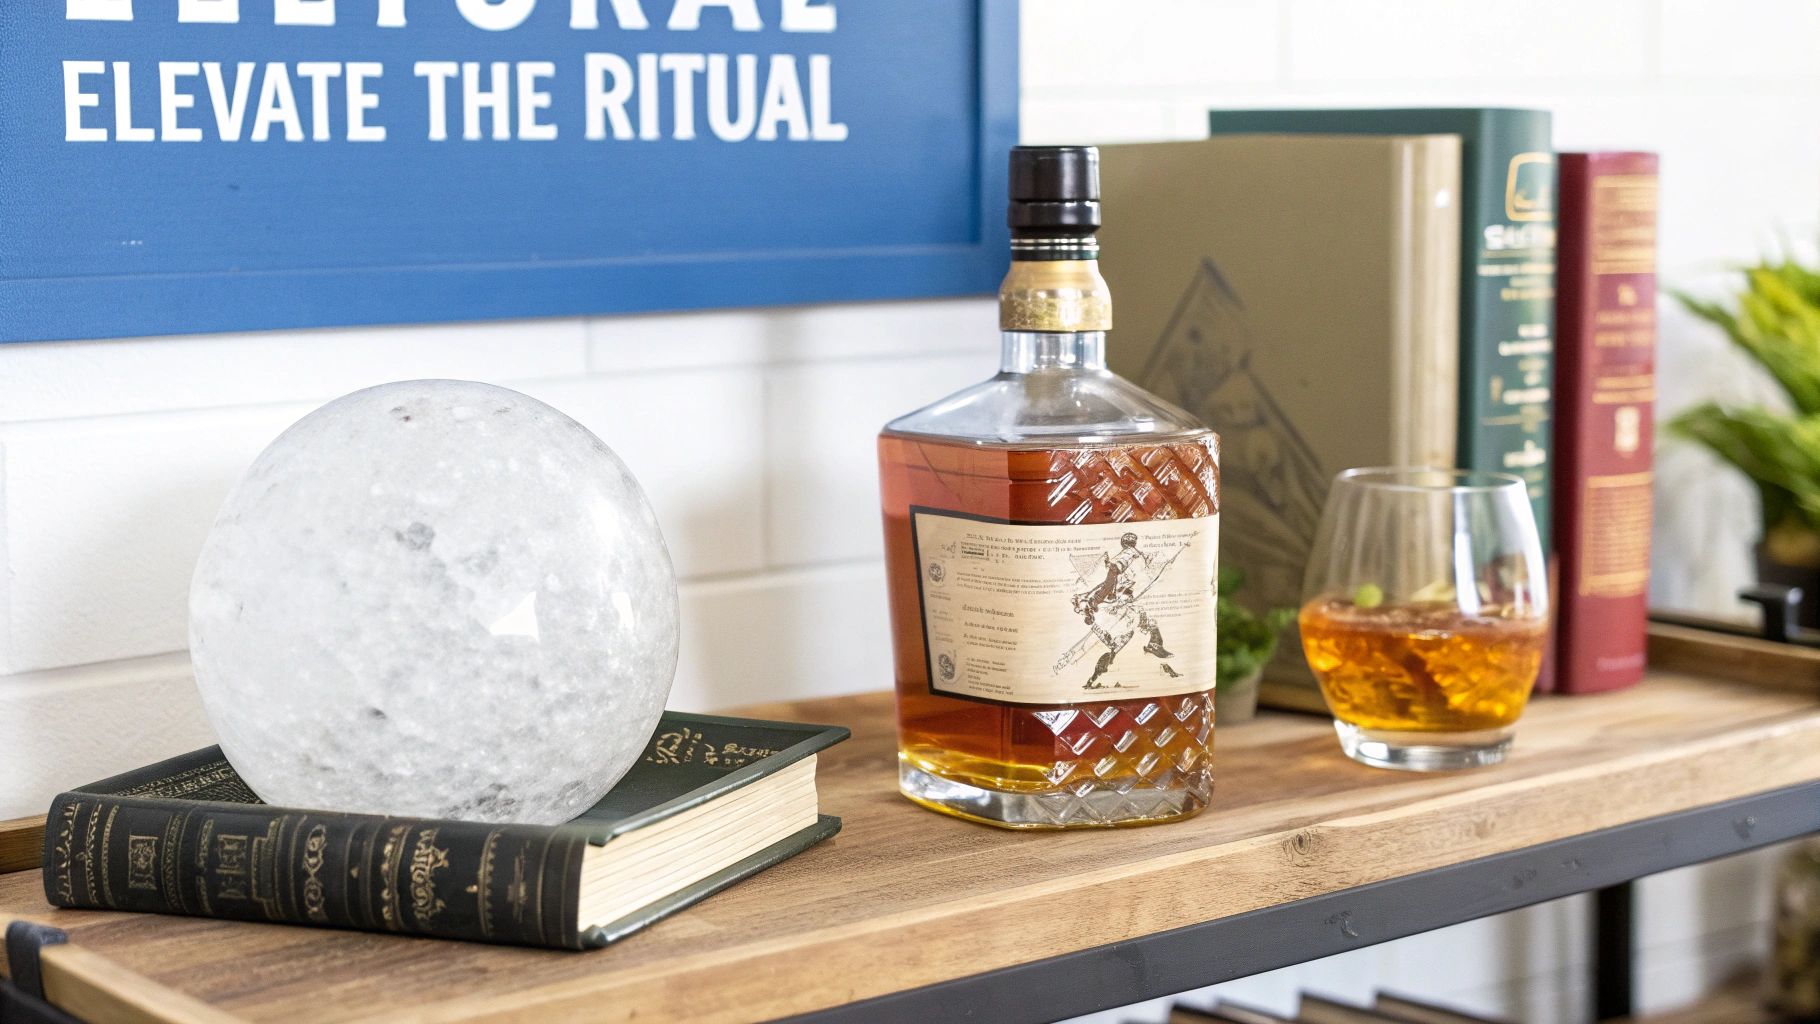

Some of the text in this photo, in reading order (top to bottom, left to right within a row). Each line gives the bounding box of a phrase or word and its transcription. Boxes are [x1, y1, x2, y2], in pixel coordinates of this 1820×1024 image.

[62, 52, 849, 143] ELEVATE THE RITUAL
